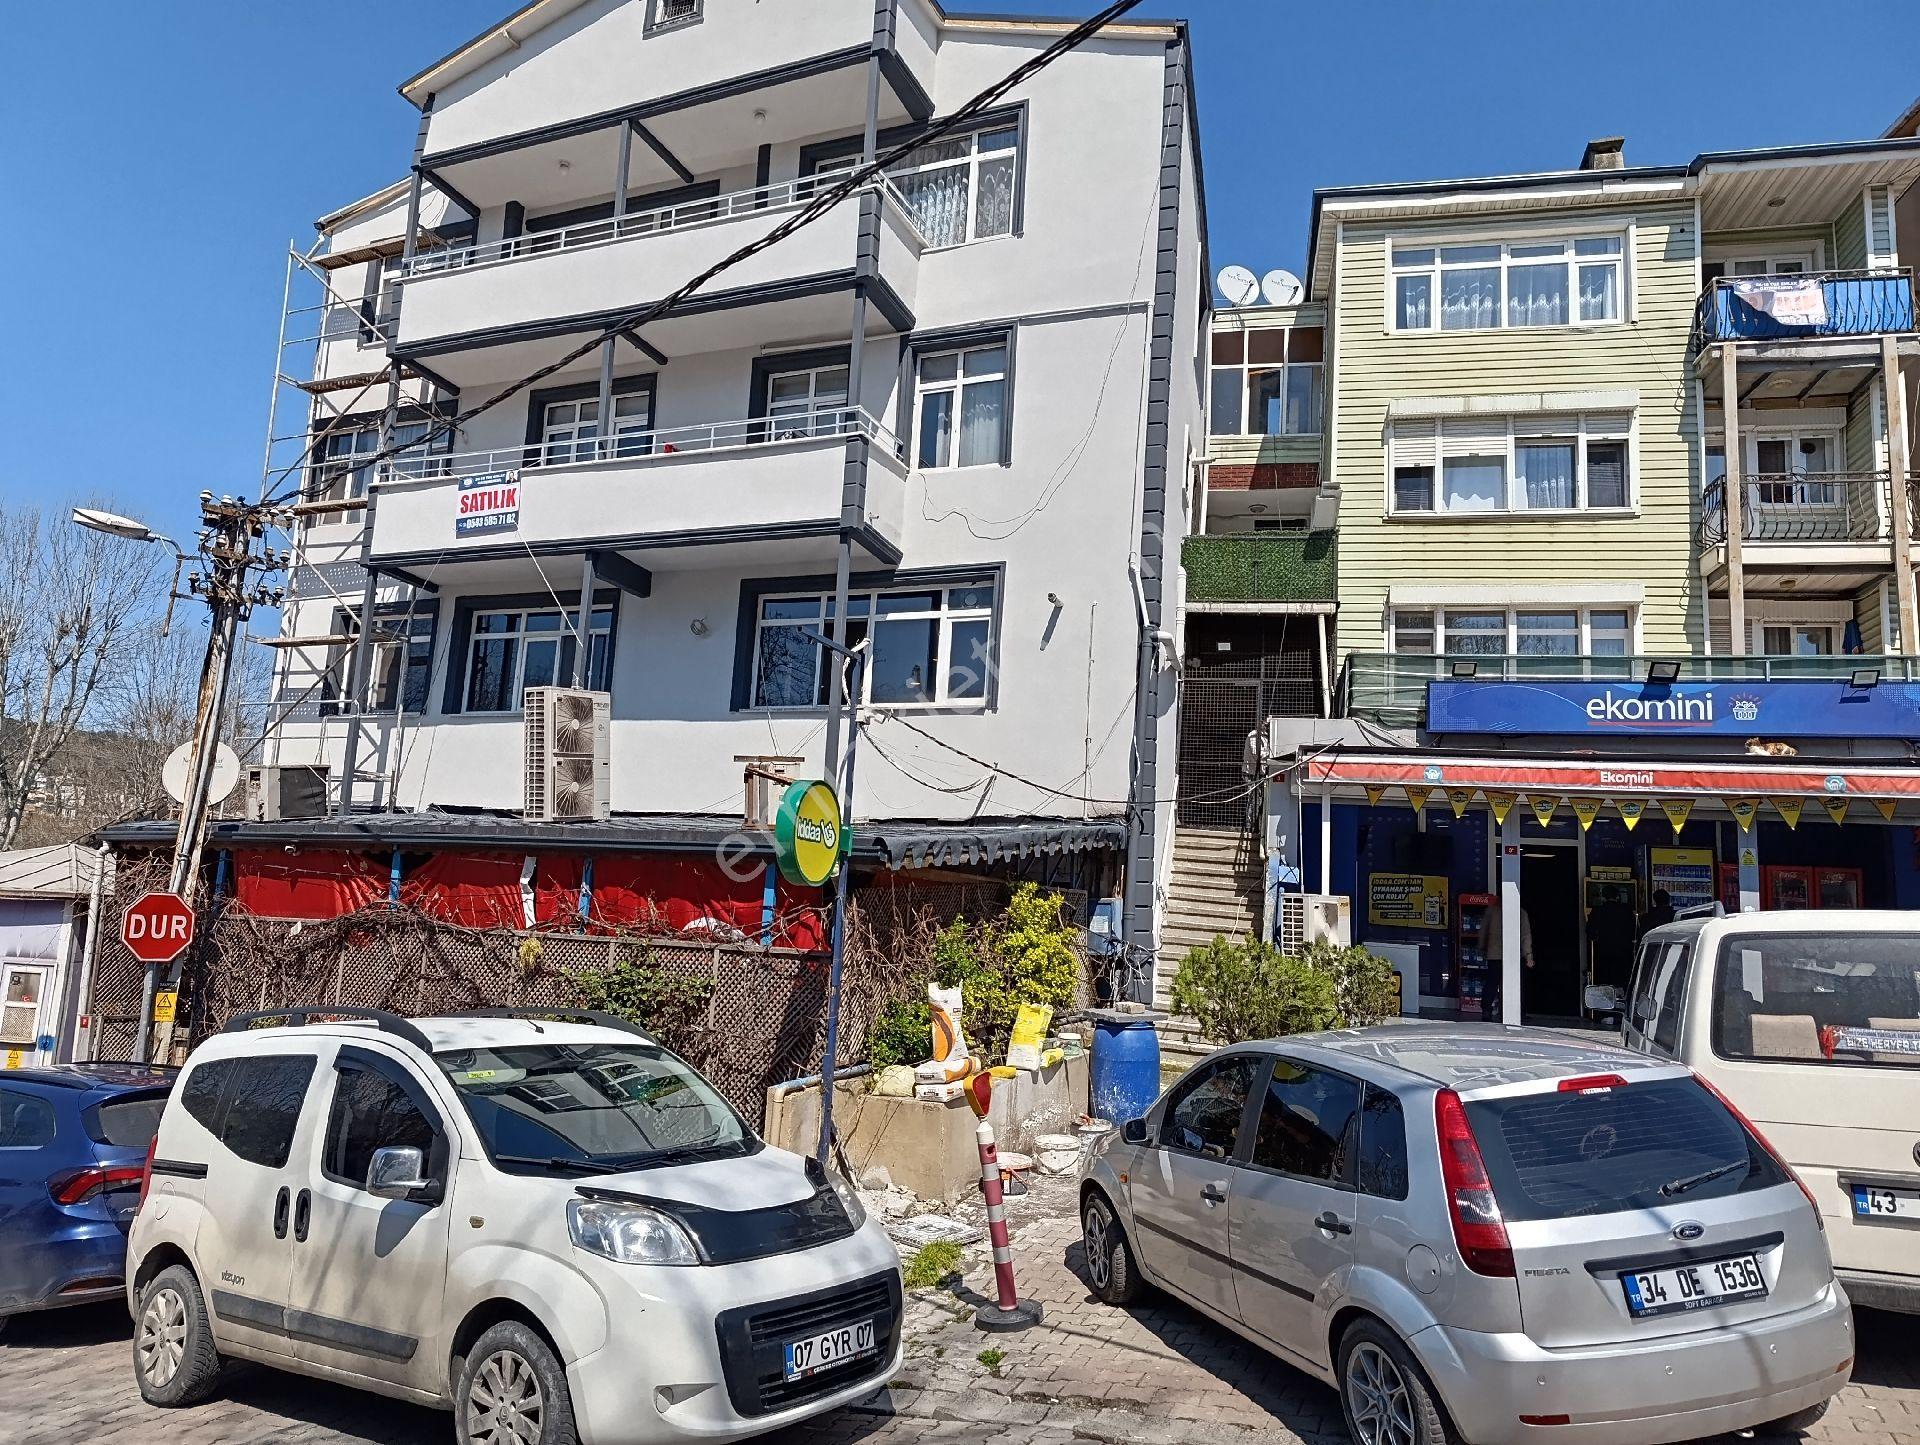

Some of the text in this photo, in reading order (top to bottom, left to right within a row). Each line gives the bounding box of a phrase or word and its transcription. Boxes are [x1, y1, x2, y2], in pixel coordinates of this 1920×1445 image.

[460, 487, 517, 514] SATILIK
[498, 514, 506, 525] 71
[1586, 690, 1713, 721] ekomini
[1600, 771, 1654, 786] Ekomini
[797, 815, 821, 843] iddaa
[128, 913, 187, 939] DUR
[1857, 1201, 1868, 1209] TR
[1871, 1191, 1897, 1213] 43
[1525, 1267, 1570, 1277] FIESTA
[1643, 1259, 1761, 1304] 34 DE 1536
[1631, 1294, 1642, 1304] TR
[794, 1323, 872, 1368] 07 GYR 07
